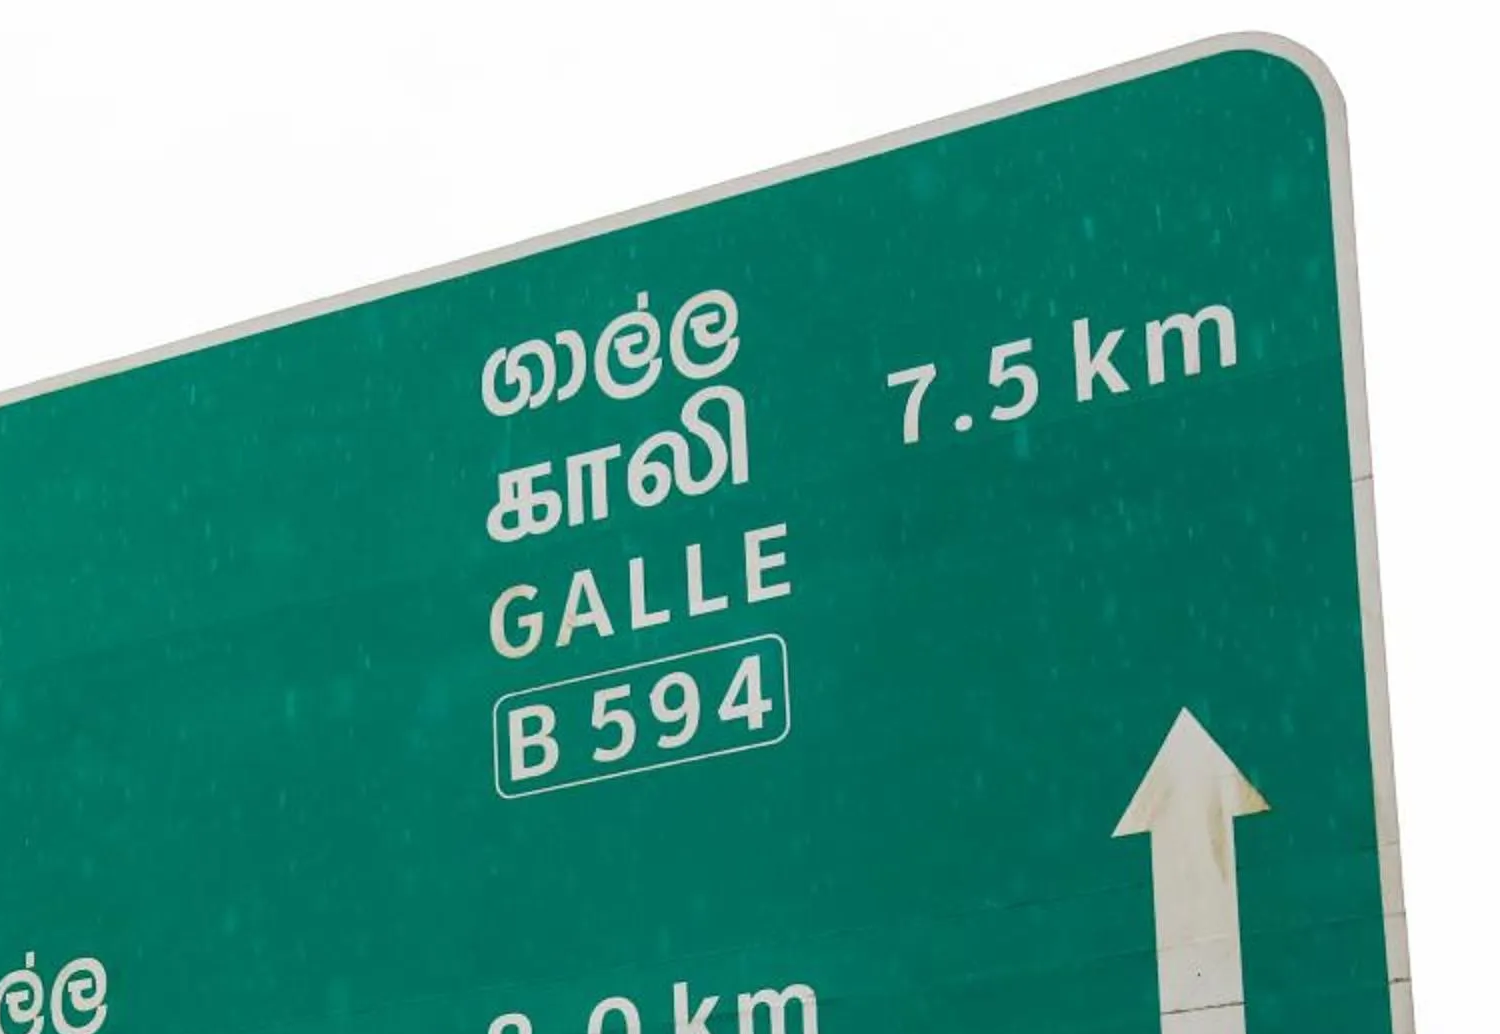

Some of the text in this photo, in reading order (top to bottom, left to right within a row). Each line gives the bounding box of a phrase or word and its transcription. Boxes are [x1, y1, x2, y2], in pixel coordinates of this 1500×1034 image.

[481, 289, 740, 417] ගාල්ල
[887, 305, 1237, 443] 7.5 km
[487, 385, 749, 542] காலி
[490, 523, 791, 658] GALLE
[509, 655, 773, 781] B 594
